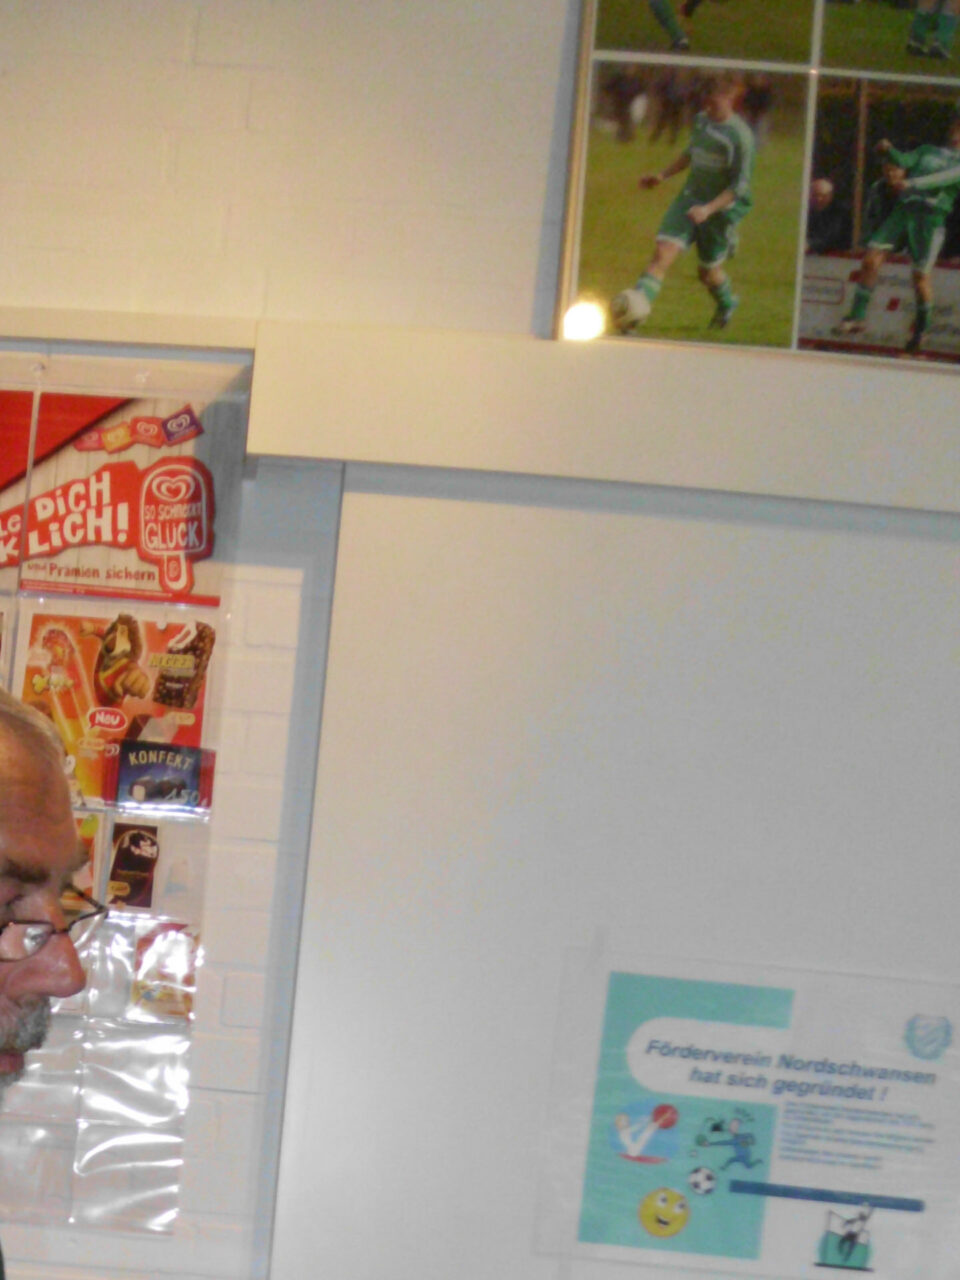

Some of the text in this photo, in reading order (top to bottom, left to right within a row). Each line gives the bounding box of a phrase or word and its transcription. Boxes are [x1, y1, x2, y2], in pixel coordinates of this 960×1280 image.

[128, 751, 194, 770] KONFEKT
[645, 1039, 937, 1085] Förderverein Nordschwansen
[690, 1068, 721, 1084] hat
[726, 1072, 768, 1089] sich
